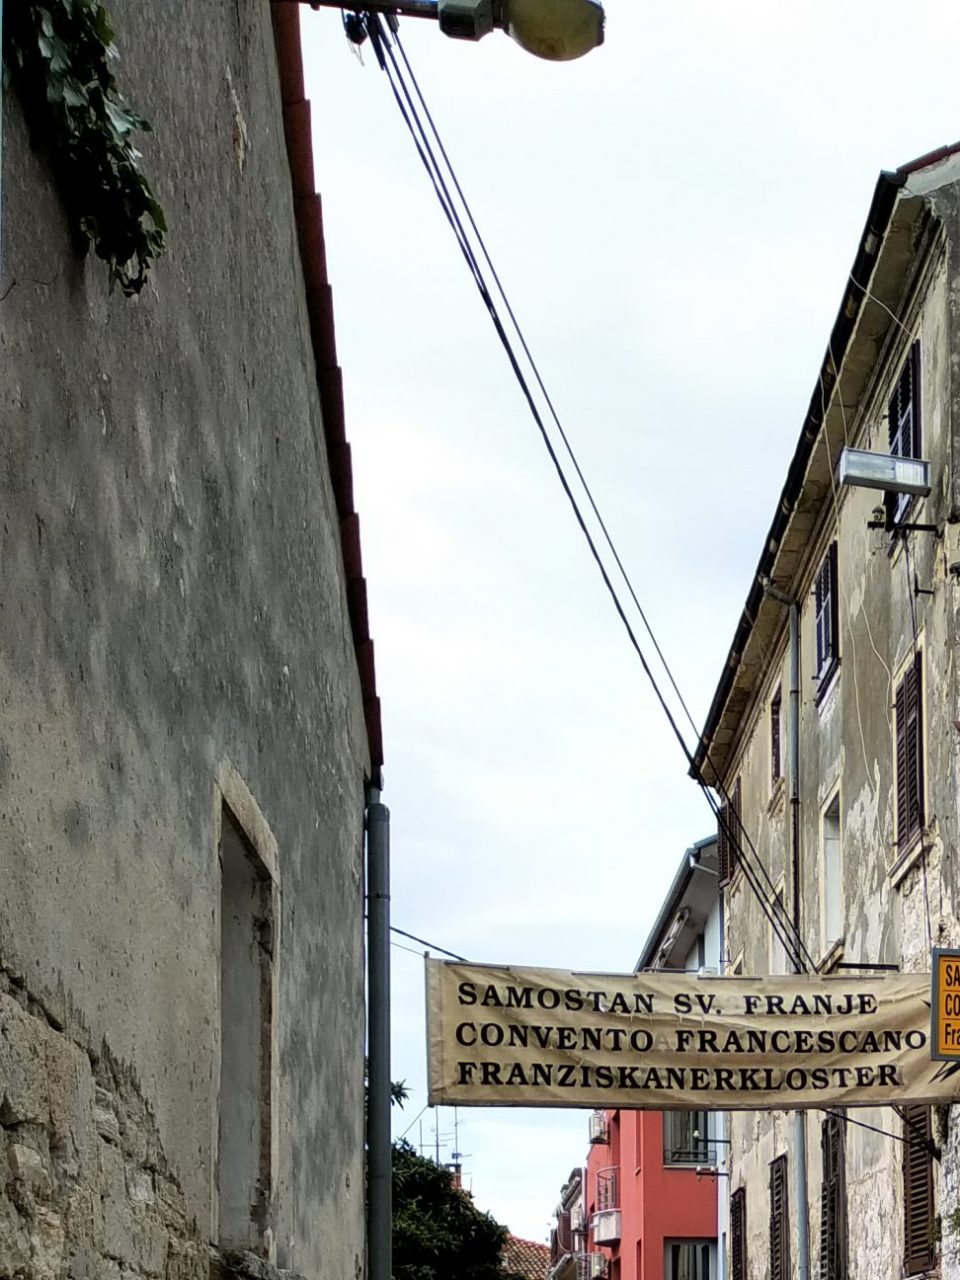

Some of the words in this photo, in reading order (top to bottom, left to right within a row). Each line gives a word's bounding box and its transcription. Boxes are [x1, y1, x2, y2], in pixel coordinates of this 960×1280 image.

[458, 982, 655, 1014] SAMOSTAN
[674, 993, 722, 1015] SV.
[744, 993, 878, 1015] FRANJE
[455, 1022, 654, 1051] CONVENTO
[675, 1029, 926, 1053] FRANCESCANO
[457, 1062, 903, 1091] FRANZISKANERKLOSTER
